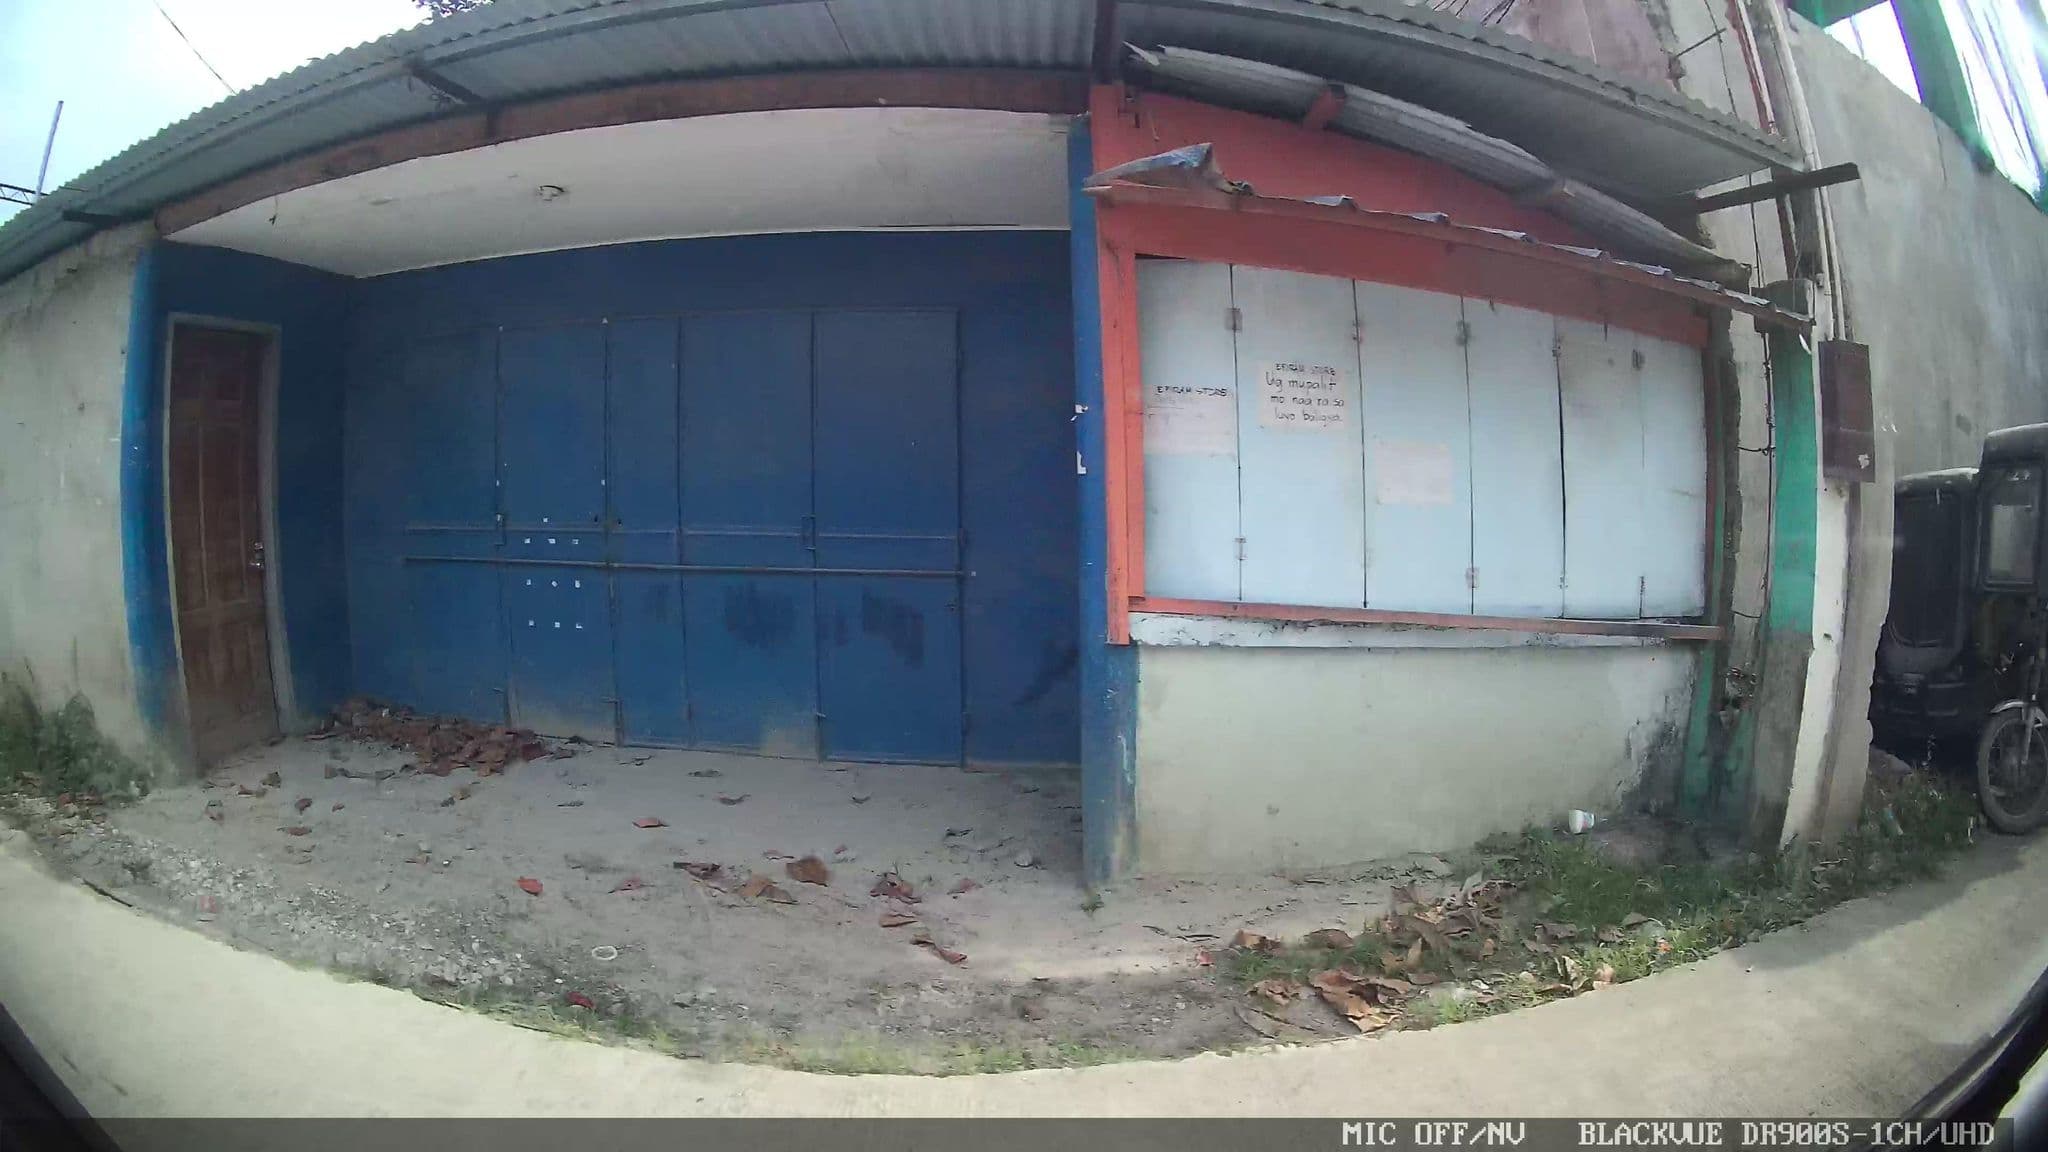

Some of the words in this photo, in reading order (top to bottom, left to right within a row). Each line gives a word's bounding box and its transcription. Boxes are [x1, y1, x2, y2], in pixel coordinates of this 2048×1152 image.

[1265, 371, 1283, 393] Ug
[1288, 375, 1337, 396] mupalit
[1270, 395, 1284, 404] mo
